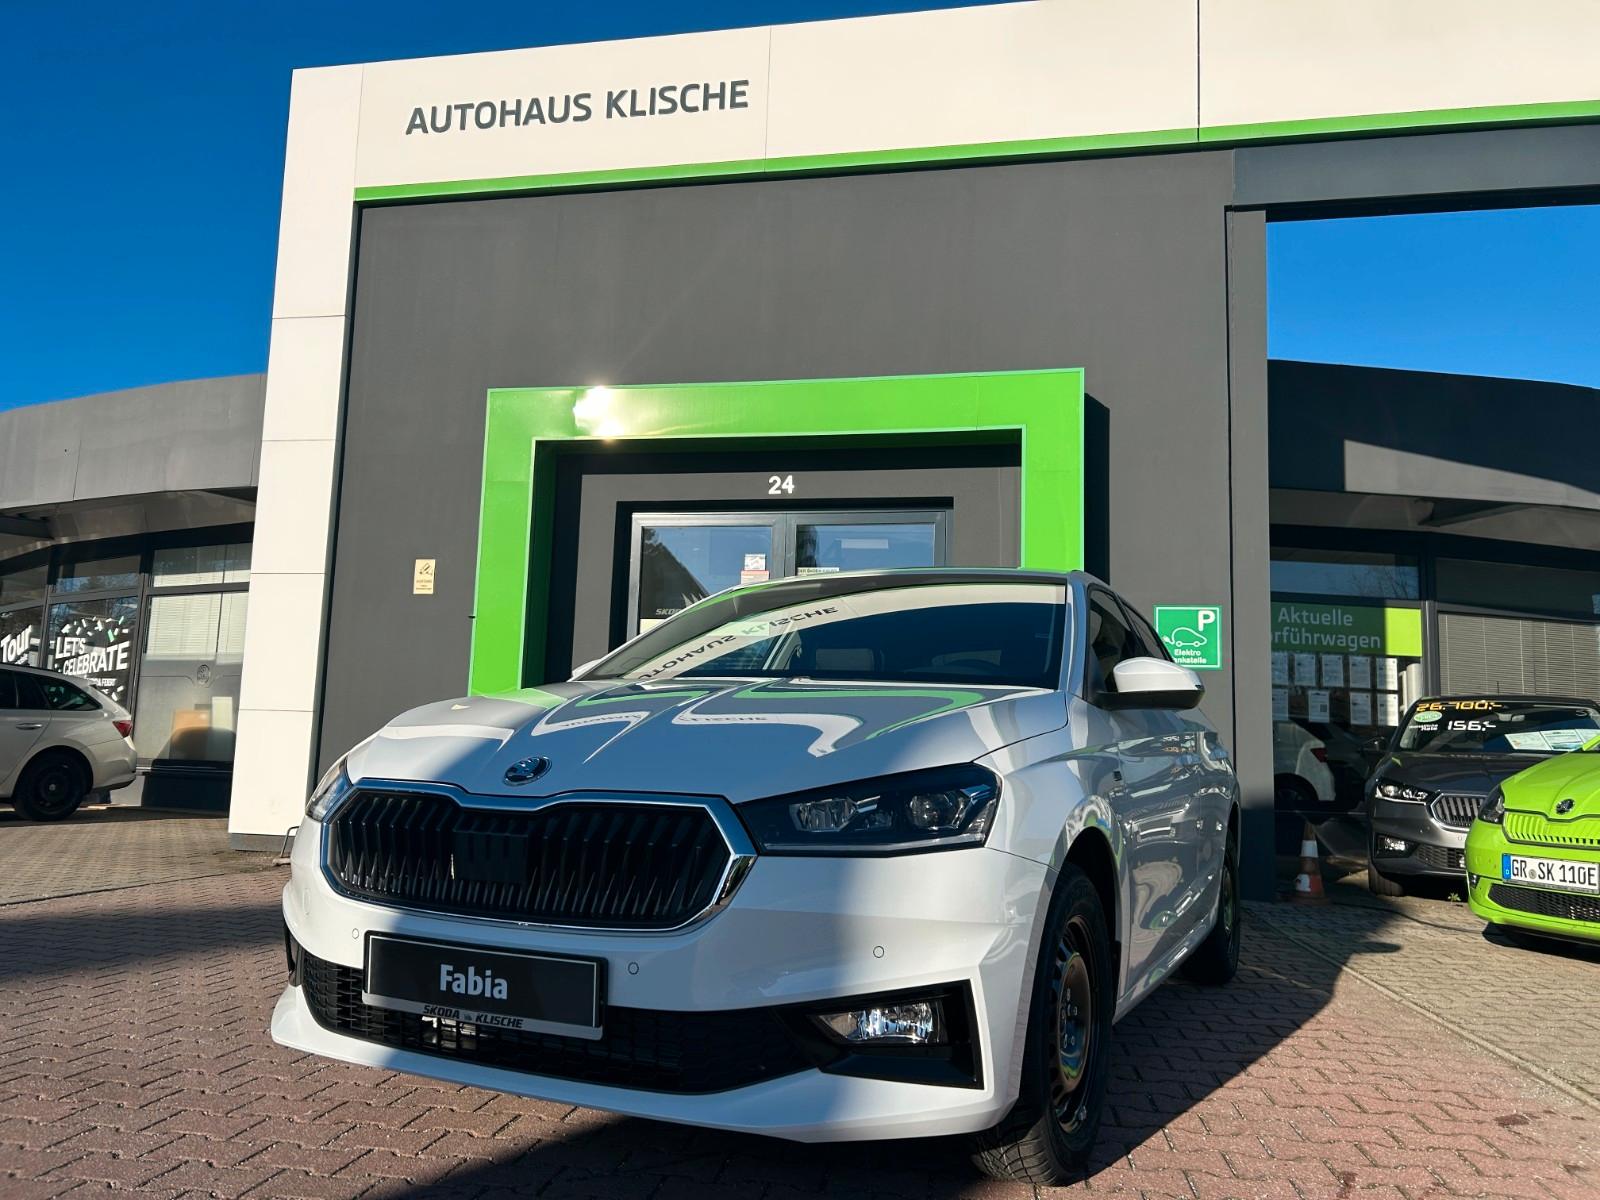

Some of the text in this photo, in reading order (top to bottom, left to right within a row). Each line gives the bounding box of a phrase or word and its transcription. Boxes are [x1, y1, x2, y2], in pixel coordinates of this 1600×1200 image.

[405, 79, 749, 135] AUTOHAUS KLISCHE
[768, 474, 795, 495] 24
[1198, 610, 1216, 632] P
[1278, 606, 1353, 626] Aktuelle
[0, 625, 32, 663] Tour
[56, 637, 86, 659] LET'S
[1271, 627, 1381, 652] rführwagen
[63, 641, 130, 675] CELEBRATE
[1173, 656, 1207, 664] ankstelle
[1174, 648, 1201, 656] Elektro
[1512, 859, 1597, 886] GR SK 110E
[440, 963, 508, 1000] Fabia
[423, 1005, 523, 1028] SKODA KLISCHE
